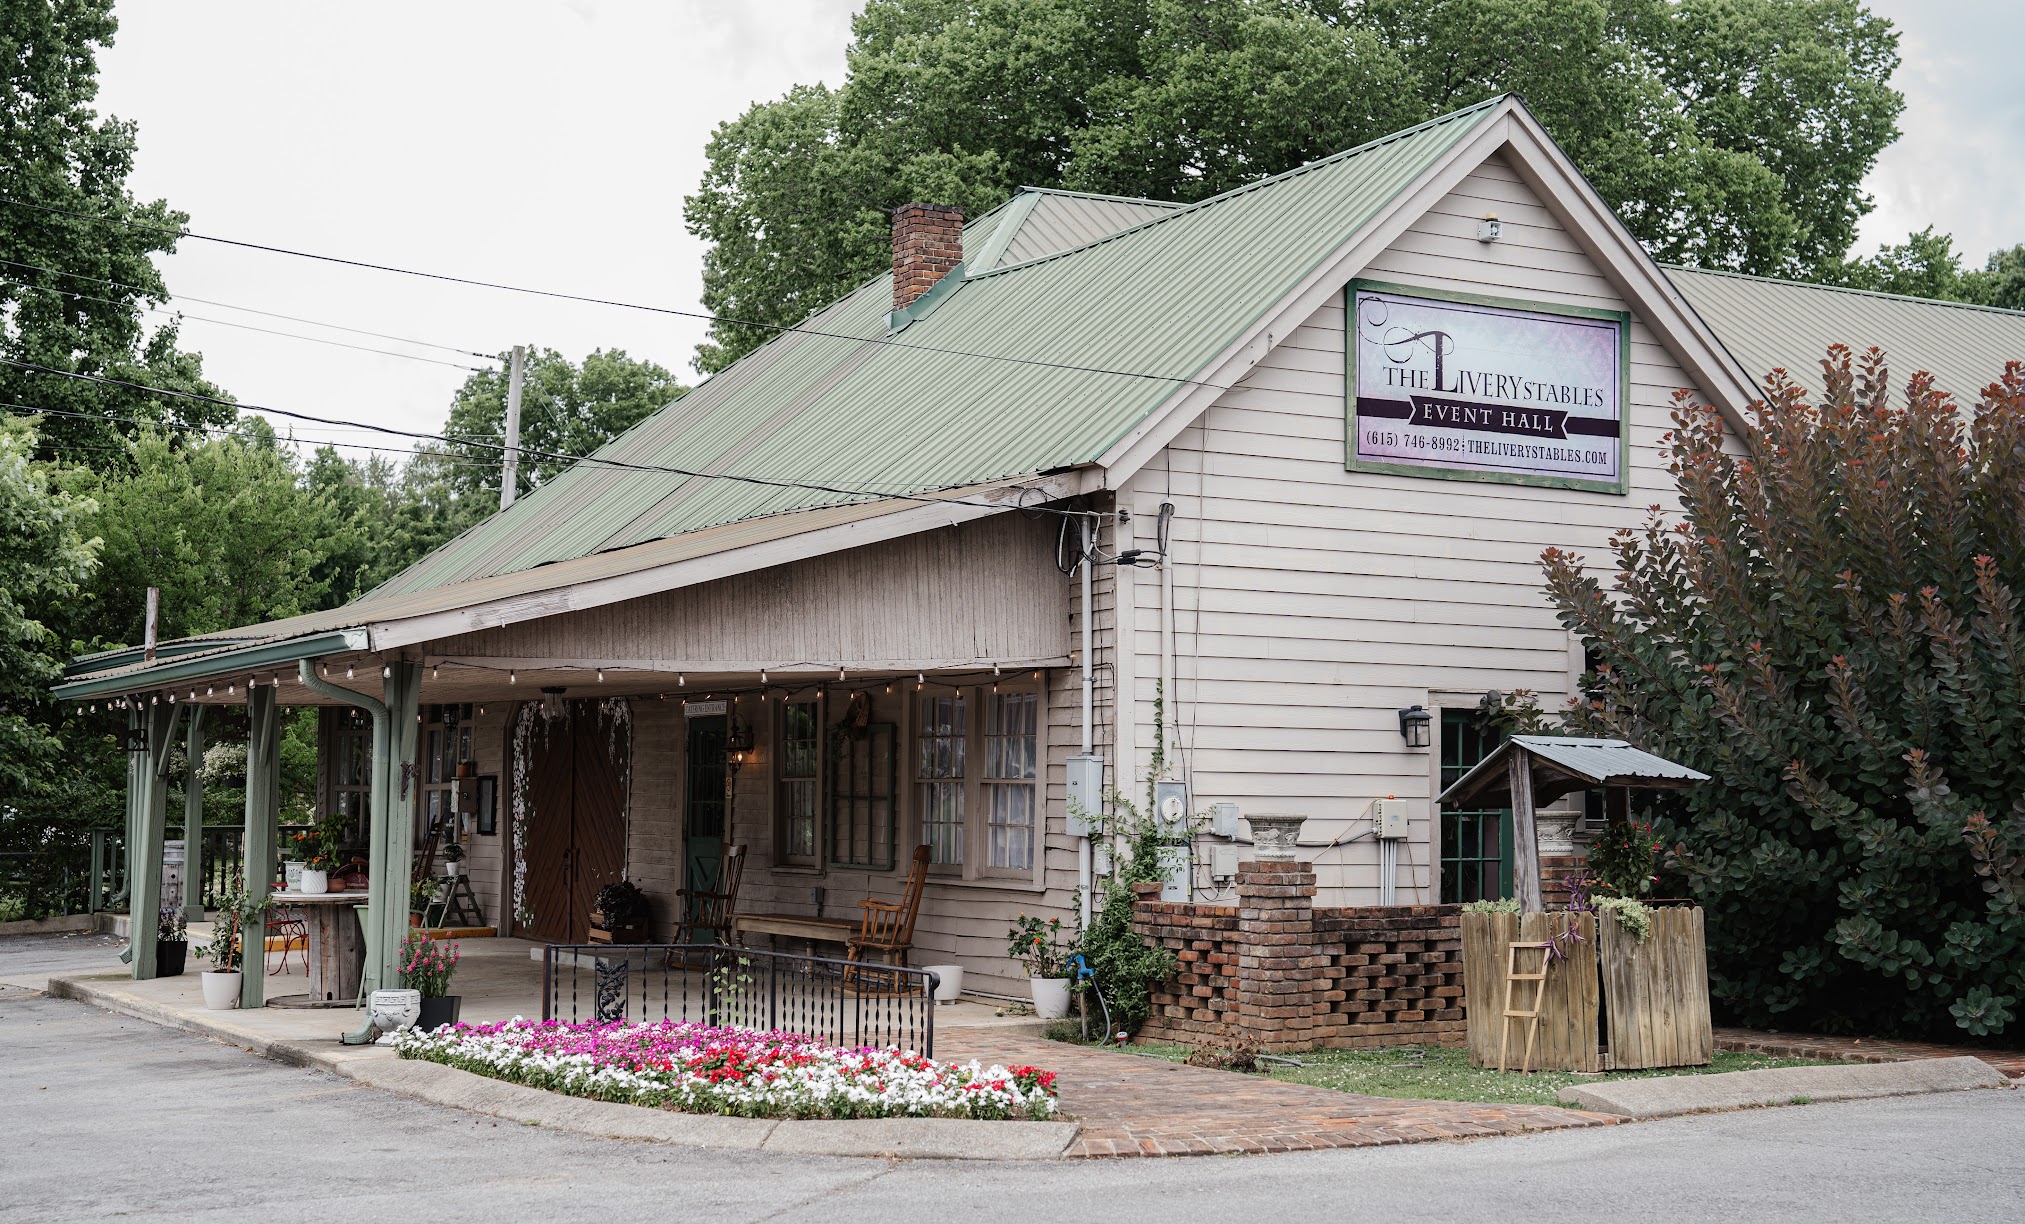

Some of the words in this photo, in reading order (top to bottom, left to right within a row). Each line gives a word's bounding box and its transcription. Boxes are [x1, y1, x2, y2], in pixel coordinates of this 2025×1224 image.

[1383, 365, 1429, 390] THE
[1423, 403, 1493, 425] EVENT
[1501, 411, 1553, 432] HALL
[1366, 430, 1398, 448] (615)
[1404, 434, 1460, 452] 746-8992
[1467, 440, 1607, 465] THELIVERYSTABLES.COM
